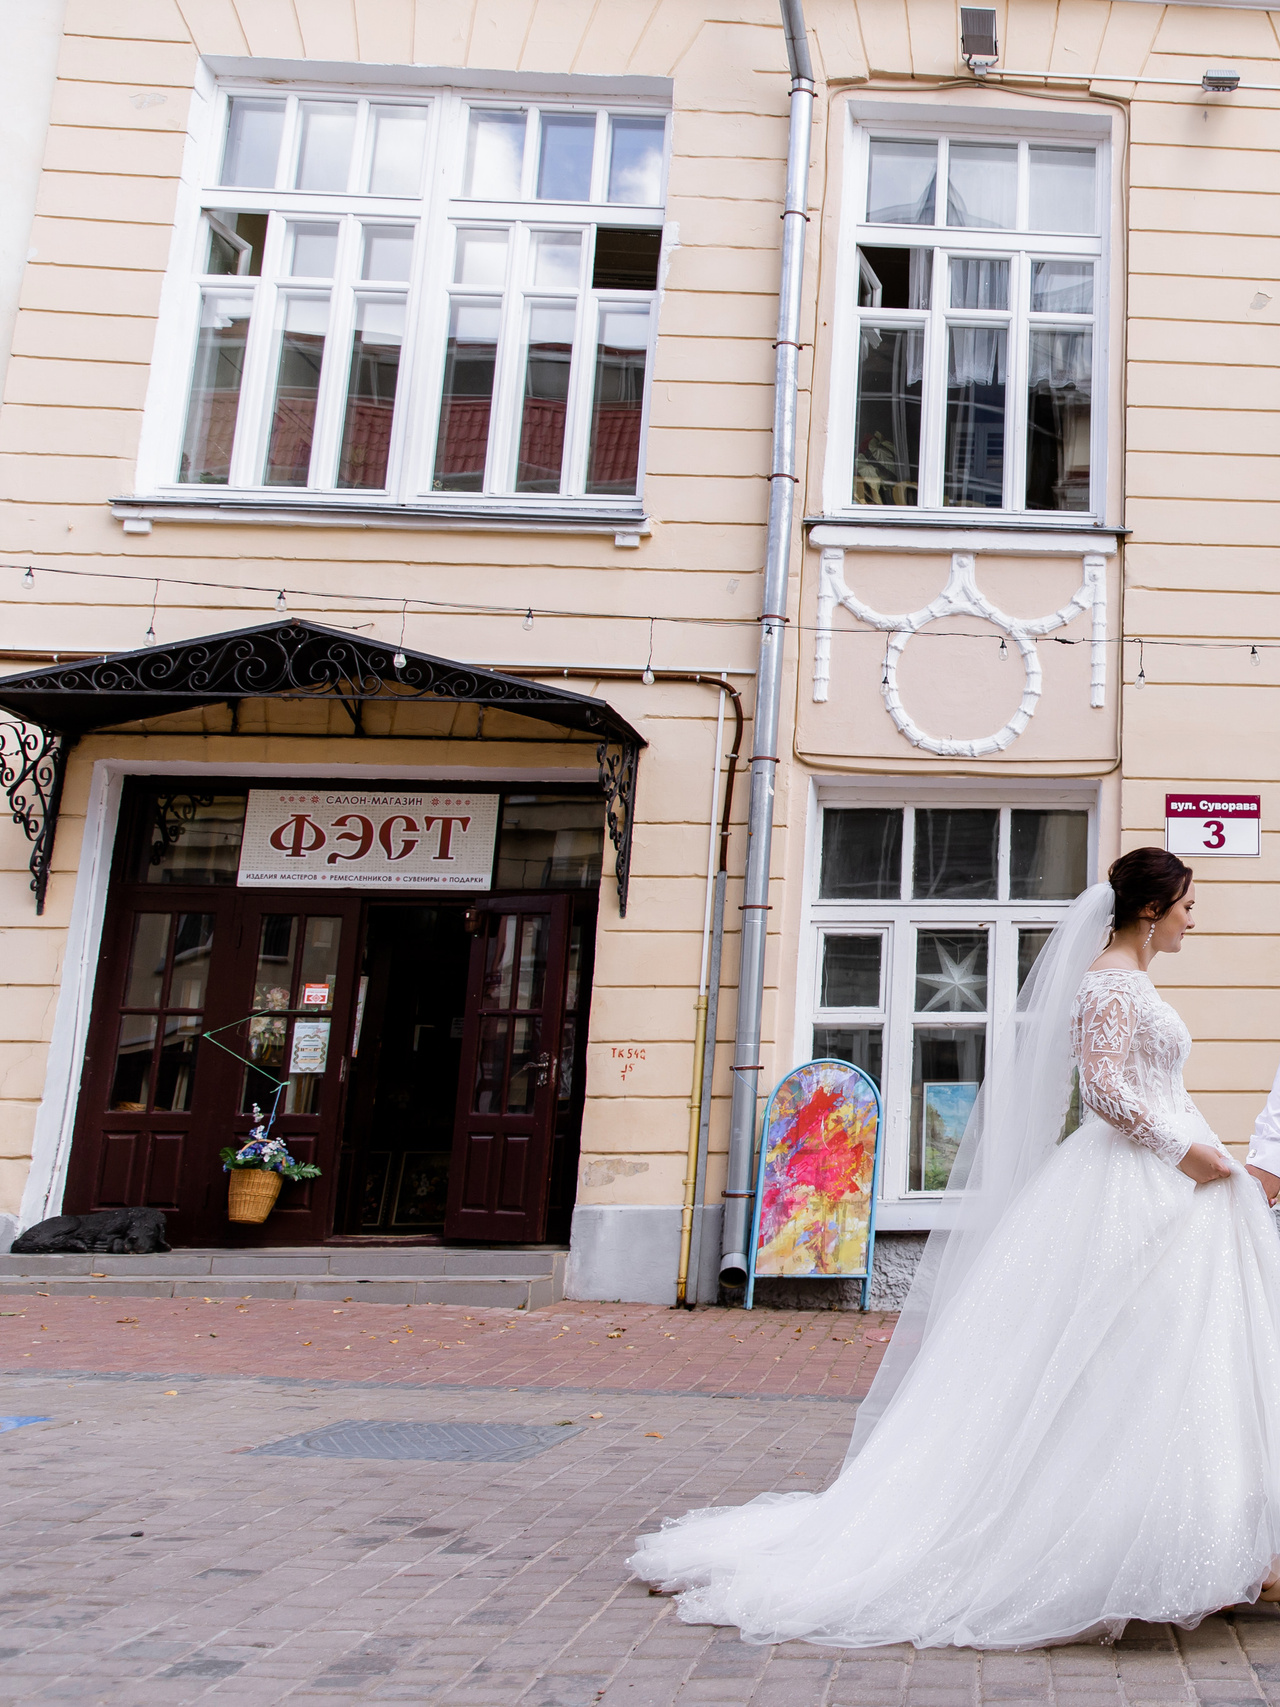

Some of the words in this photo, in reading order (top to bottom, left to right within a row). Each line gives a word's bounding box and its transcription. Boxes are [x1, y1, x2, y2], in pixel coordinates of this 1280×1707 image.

[326, 795, 423, 806] САЛОН-МАГАЗИН
[1170, 802, 1196, 812] вул.
[1199, 800, 1258, 812] Суворава
[269, 813, 471, 864] ФЭСТ
[1202, 820, 1226, 849] 3
[449, 876, 484, 884] ПОДАРКИ
